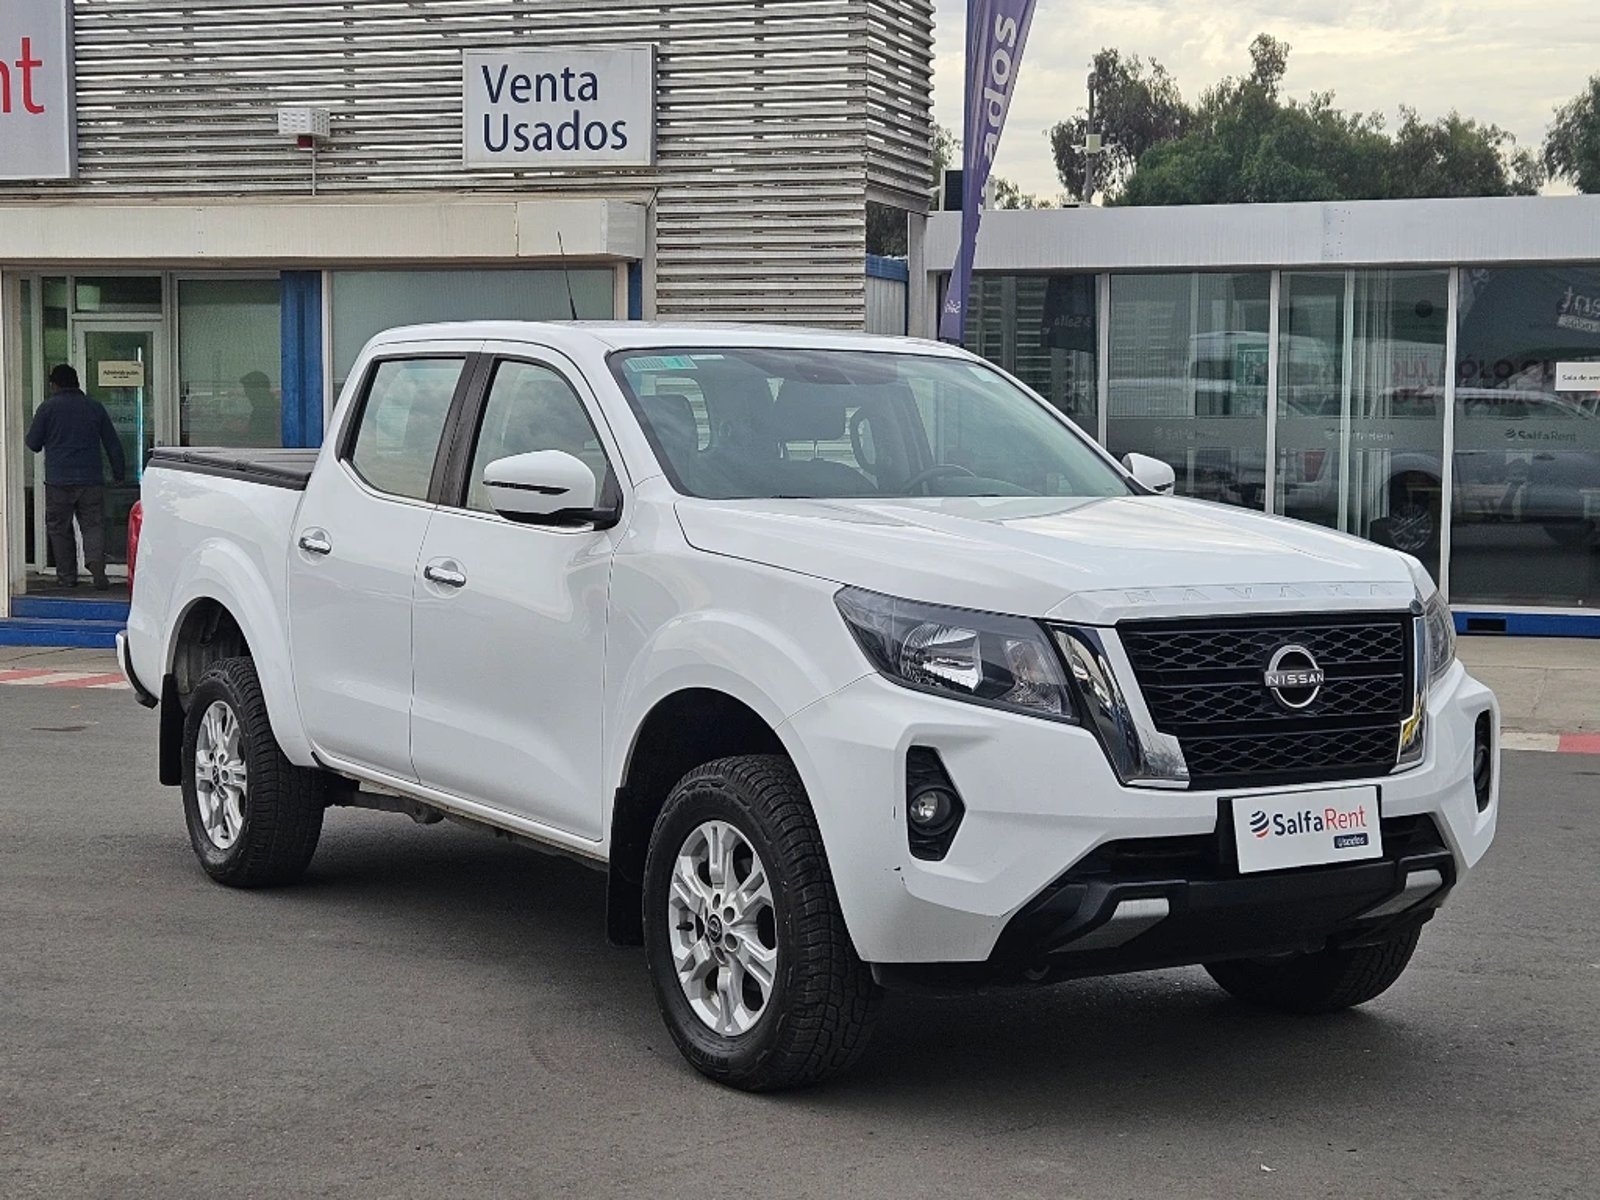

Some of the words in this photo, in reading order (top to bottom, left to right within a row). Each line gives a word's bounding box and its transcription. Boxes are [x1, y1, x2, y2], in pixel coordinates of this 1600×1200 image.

[481, 64, 598, 103] Venta
[484, 109, 628, 153] Usados
[1124, 583, 1392, 604] NAVARA
[1268, 673, 1324, 686] NISSAN
[1273, 805, 1367, 837] SalfaRent
